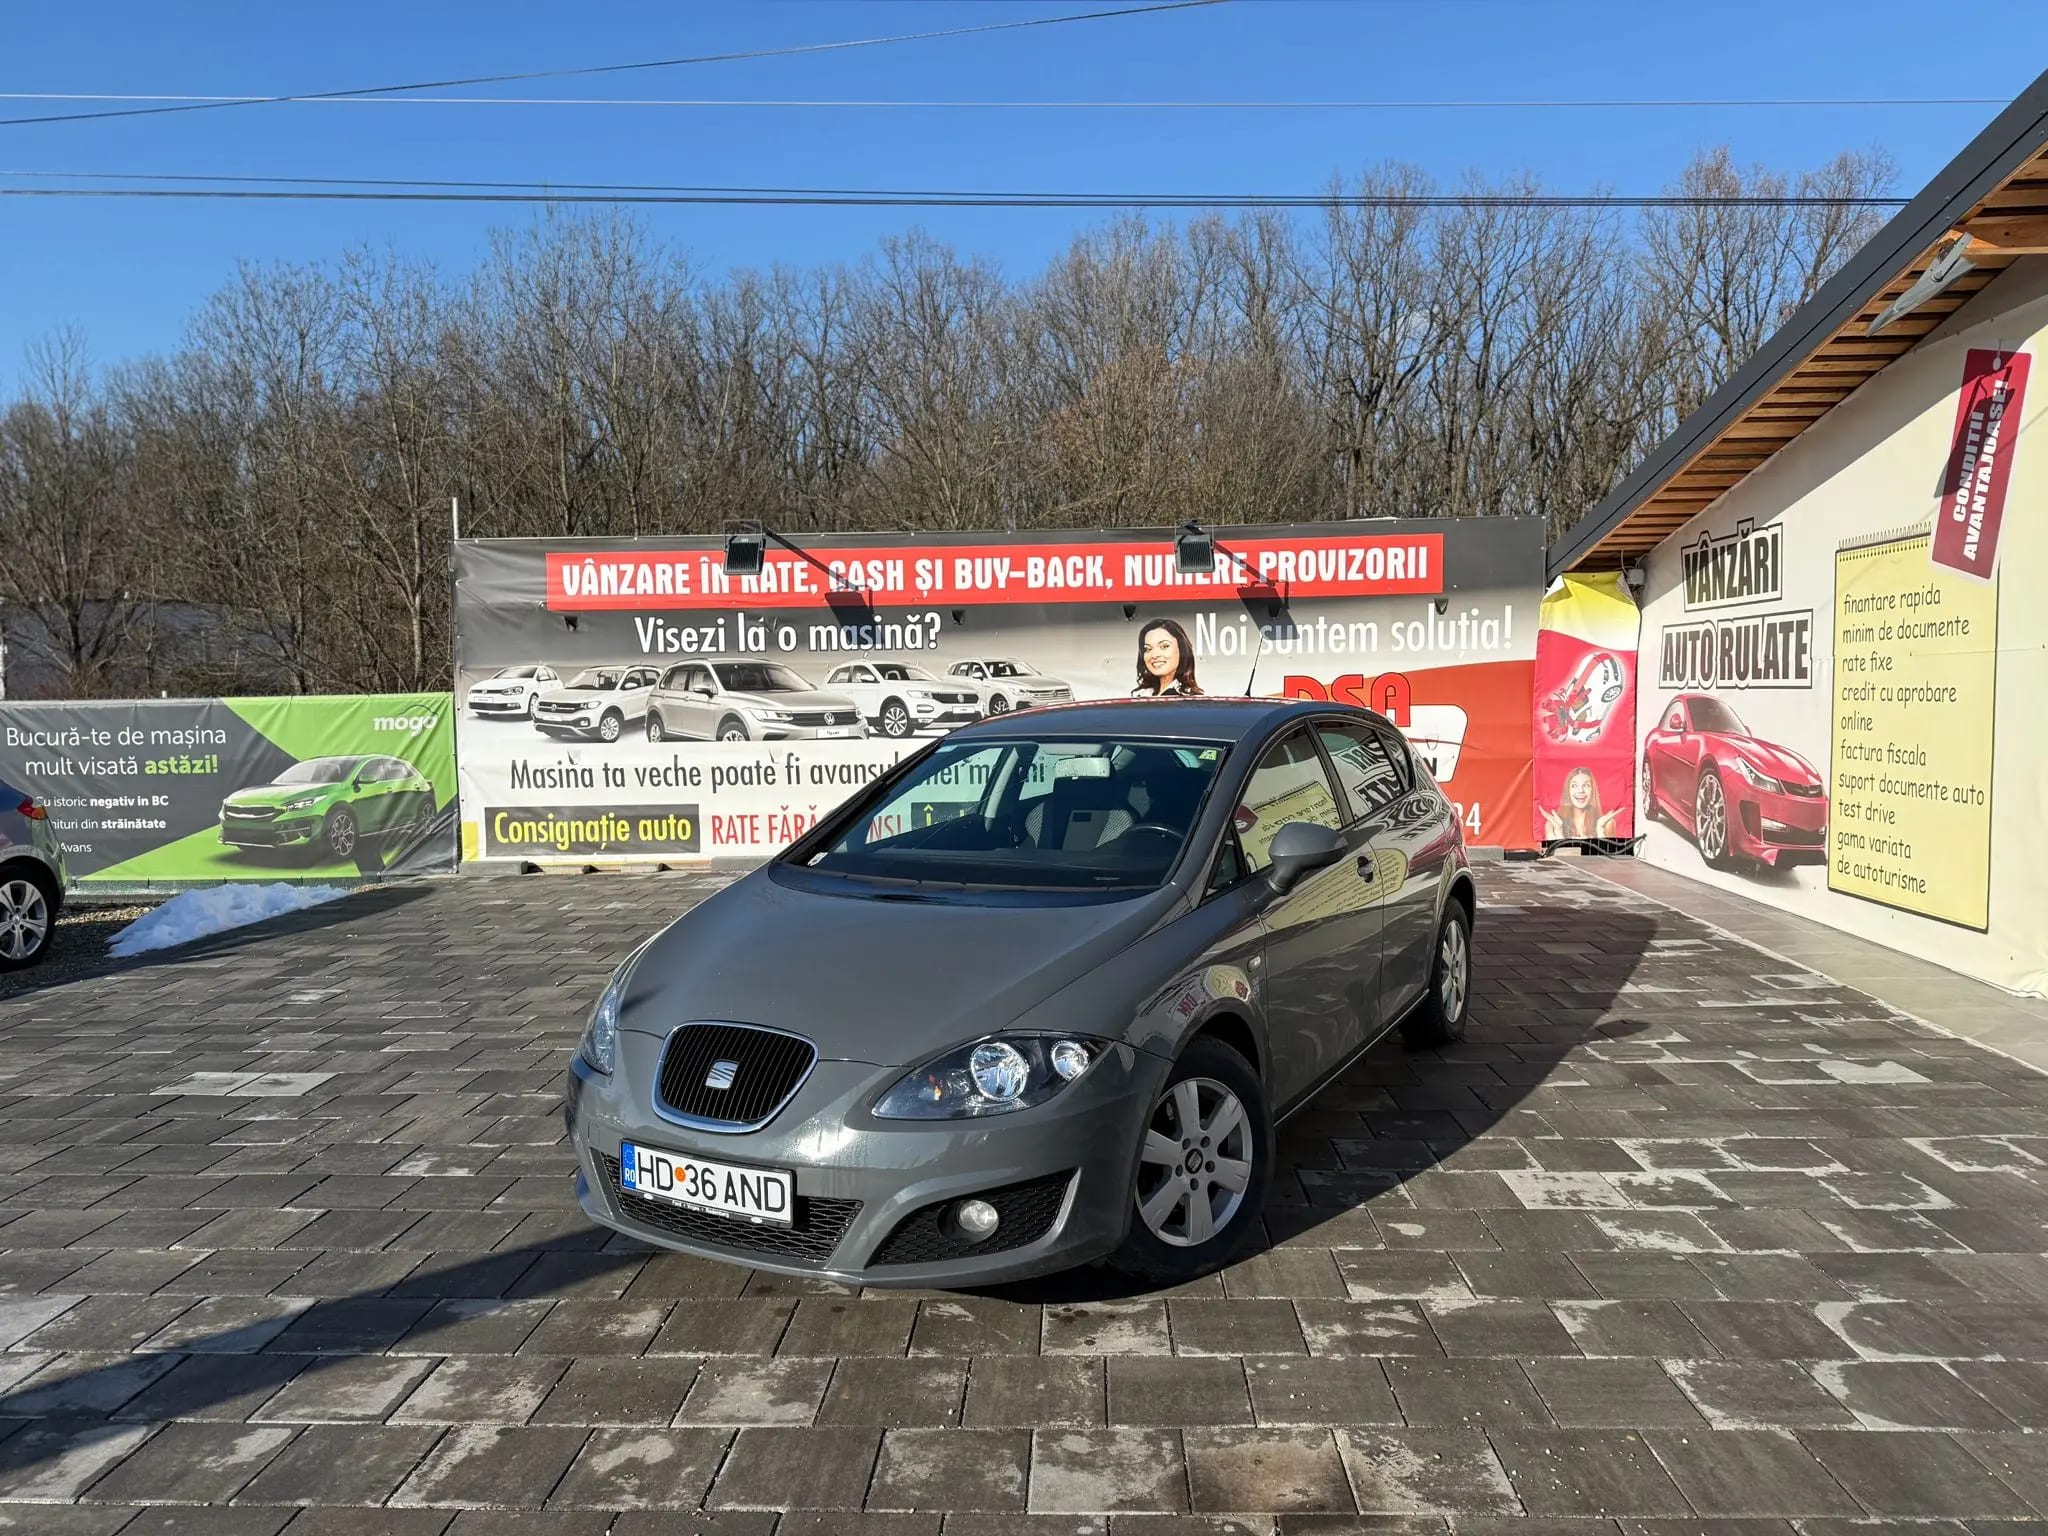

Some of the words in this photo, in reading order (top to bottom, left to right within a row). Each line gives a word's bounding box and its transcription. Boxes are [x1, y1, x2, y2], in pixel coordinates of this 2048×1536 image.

[562, 557, 691, 597] VÂNZARE
[828, 558, 904, 593] CASH
[1259, 546, 1428, 583] PROVIZORII
[1684, 529, 1779, 605] VÂNZĂRI
[1843, 592, 1896, 615] finantare
[1899, 582, 1941, 614] rapida
[634, 615, 726, 654] Visezi
[777, 625, 799, 652] o
[1195, 612, 1248, 657] Noi
[1260, 616, 1379, 656] suntem
[1842, 623, 1875, 644] minim
[1878, 619, 1893, 641] de
[1896, 615, 1970, 640] documente
[1662, 627, 1716, 682] AUTO
[1717, 619, 1809, 681] RULATE
[1842, 654, 1866, 673] rate
[1870, 650, 1893, 673] fixe
[1841, 681, 1876, 702] credit
[1879, 687, 1893, 702] cu
[1896, 680, 1957, 709] aprobare
[373, 715, 438, 737] mogo
[1840, 710, 1873, 732] online
[6, 727, 111, 747] Bucură-te
[118, 726, 145, 746] de
[151, 725, 227, 749] mașina
[25, 757, 74, 776] mult
[78, 756, 138, 776] visată
[144, 754, 219, 774] astăzi!
[1840, 738, 1883, 762] factura
[1886, 742, 1927, 767] fiscala
[602, 762, 625, 788] ta
[634, 754, 702, 787] veche
[711, 760, 776, 794] poate
[785, 752, 801, 785] fi
[53, 796, 88, 807] istoric
[90, 796, 135, 809] negativ
[151, 795, 169, 807] BC
[1838, 772, 1875, 796] suport
[1879, 772, 1949, 801] documente
[1952, 784, 1986, 806] auto
[80, 818, 99, 830] din
[1838, 798, 1862, 820] test
[1865, 801, 1896, 825] drive
[494, 811, 631, 851] Consignație
[638, 813, 692, 842] auto
[711, 814, 760, 845] RATE
[1837, 831, 1866, 850] gama
[1868, 835, 1912, 859] variata
[1837, 854, 1851, 876] de
[1853, 862, 1927, 895] autoturisme
[625, 1167, 636, 1182] RO
[638, 1151, 674, 1193] HD
[684, 1163, 717, 1201] 36
[724, 1170, 786, 1213] AND
